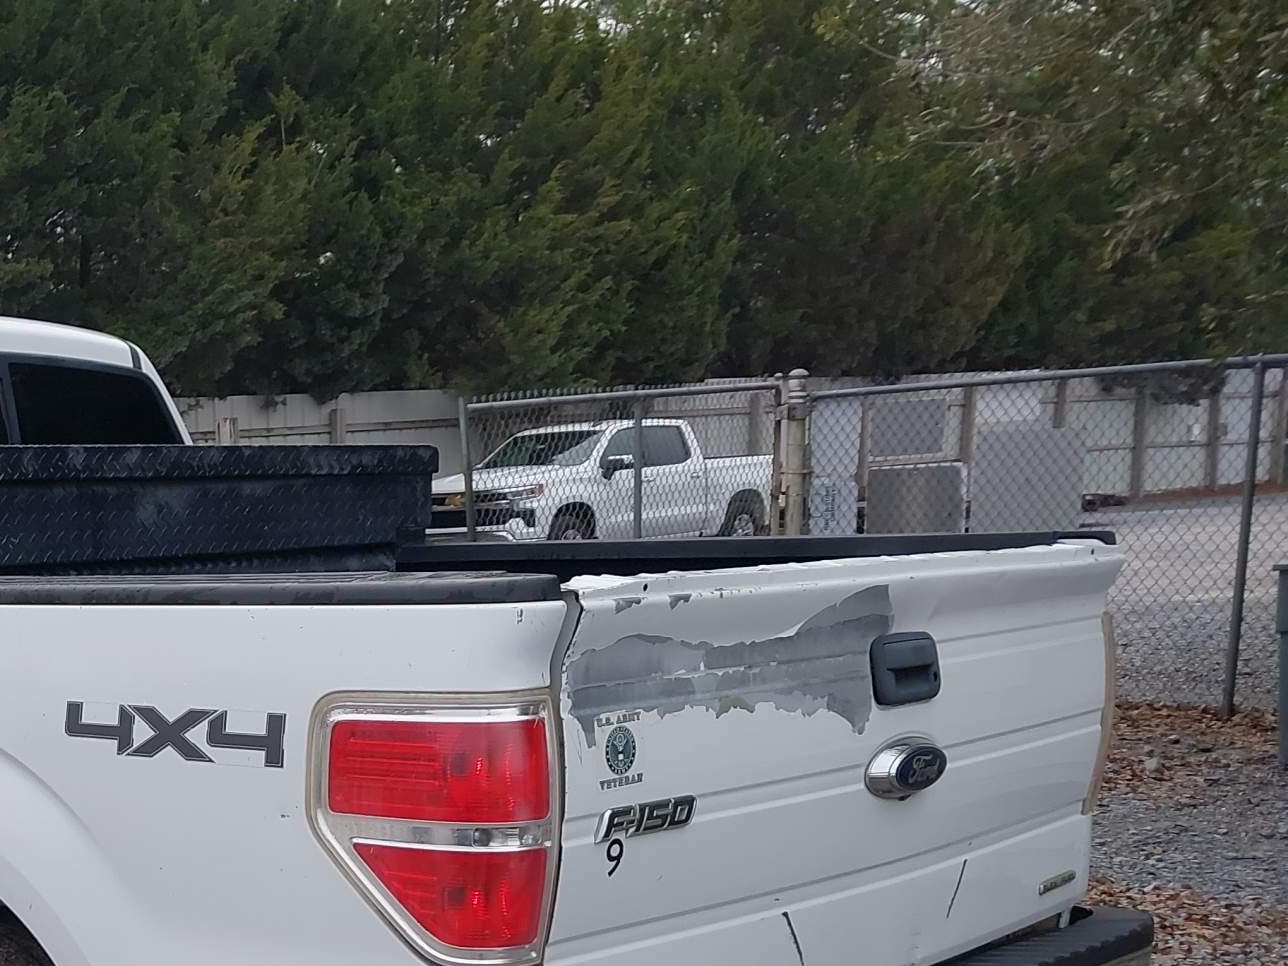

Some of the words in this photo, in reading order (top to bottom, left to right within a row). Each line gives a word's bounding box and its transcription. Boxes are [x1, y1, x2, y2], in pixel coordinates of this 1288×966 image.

[616, 711, 642, 725] ARMY
[600, 772, 643, 790] VETERAN
[908, 754, 940, 784] Ford
[594, 794, 698, 844] F-150
[606, 838, 624, 878] 9
